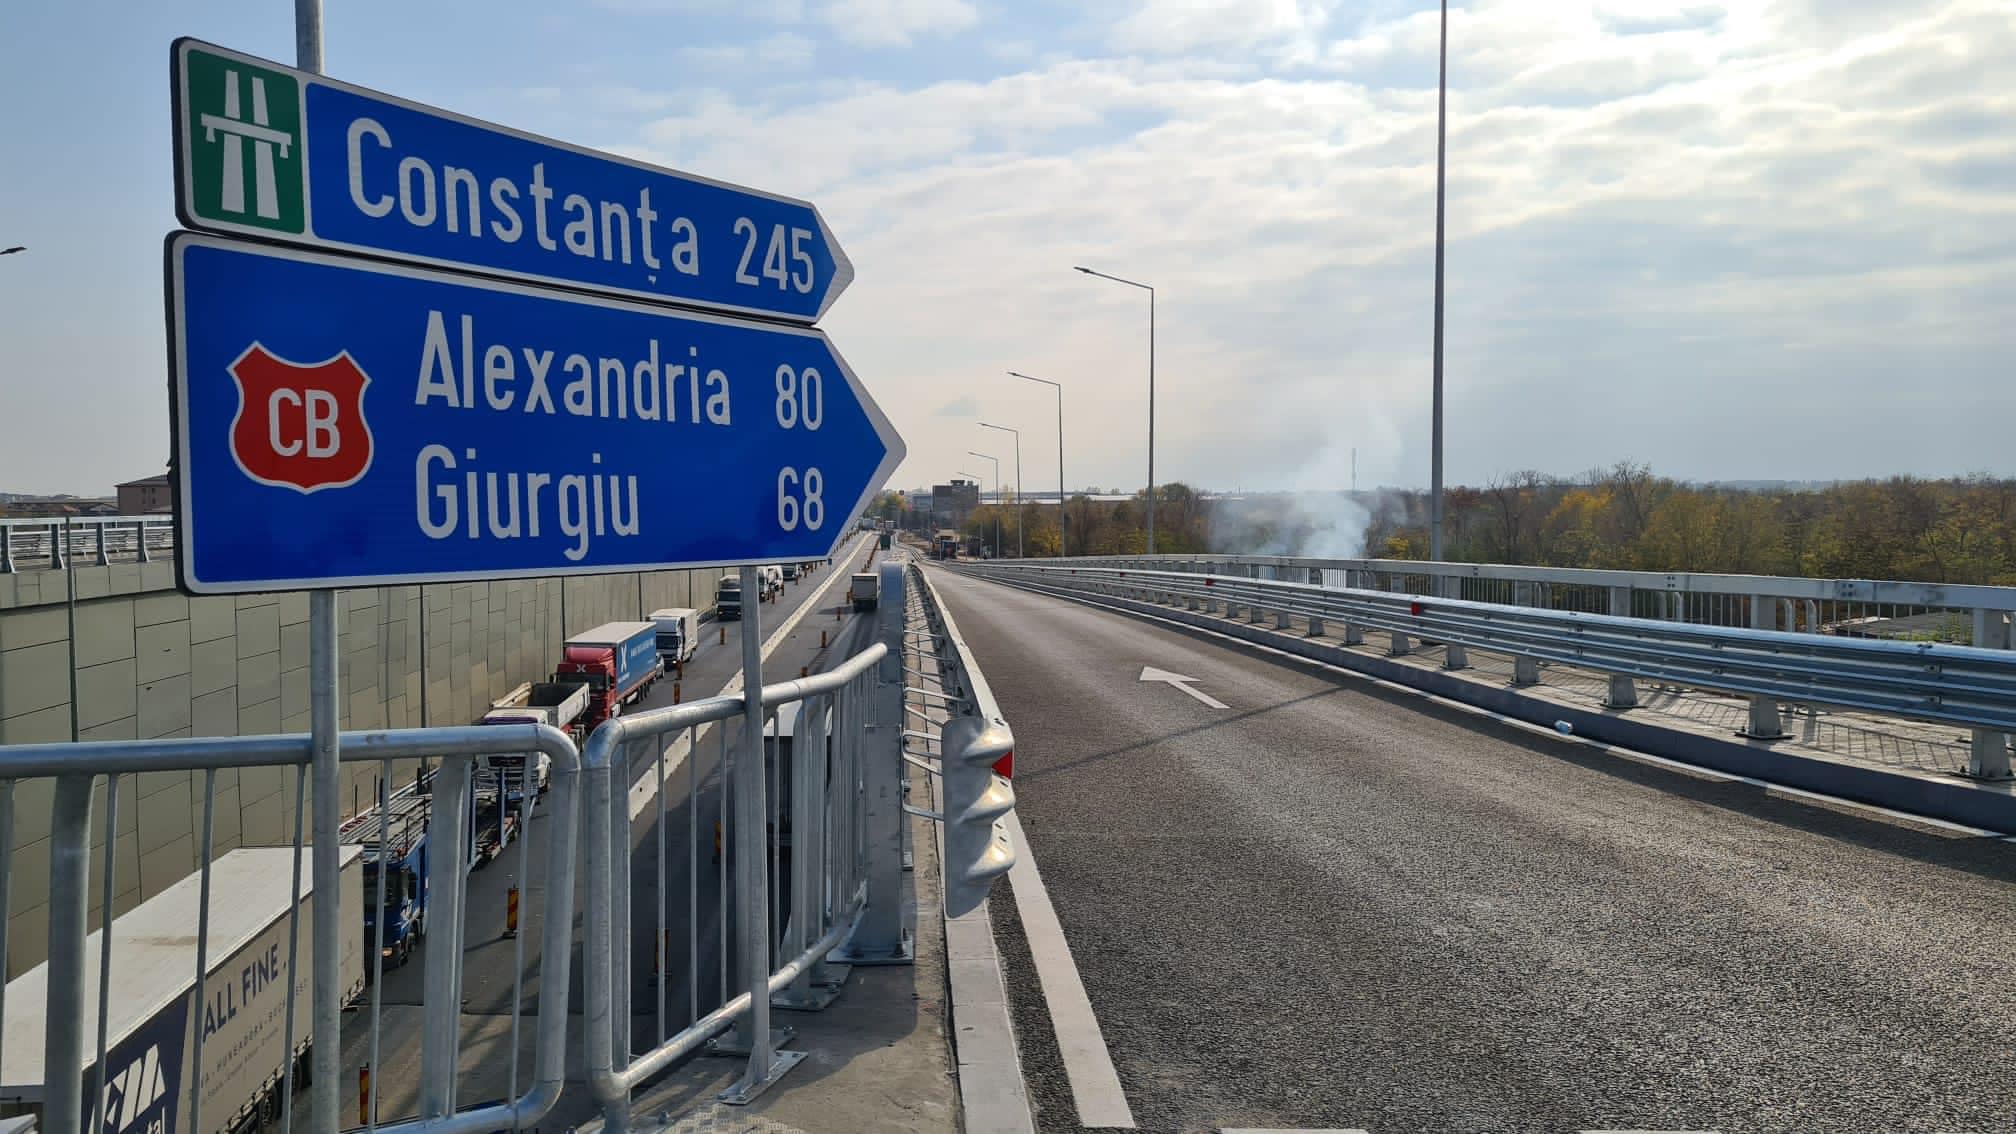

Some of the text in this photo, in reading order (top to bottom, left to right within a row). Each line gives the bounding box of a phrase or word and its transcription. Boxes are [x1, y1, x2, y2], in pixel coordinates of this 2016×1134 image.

[347, 118, 815, 294] Constanța 245
[268, 387, 341, 458] CB
[415, 310, 823, 431] Alexandria 80
[415, 444, 824, 561] Giurgiu 68
[203, 982, 236, 1043] ALL
